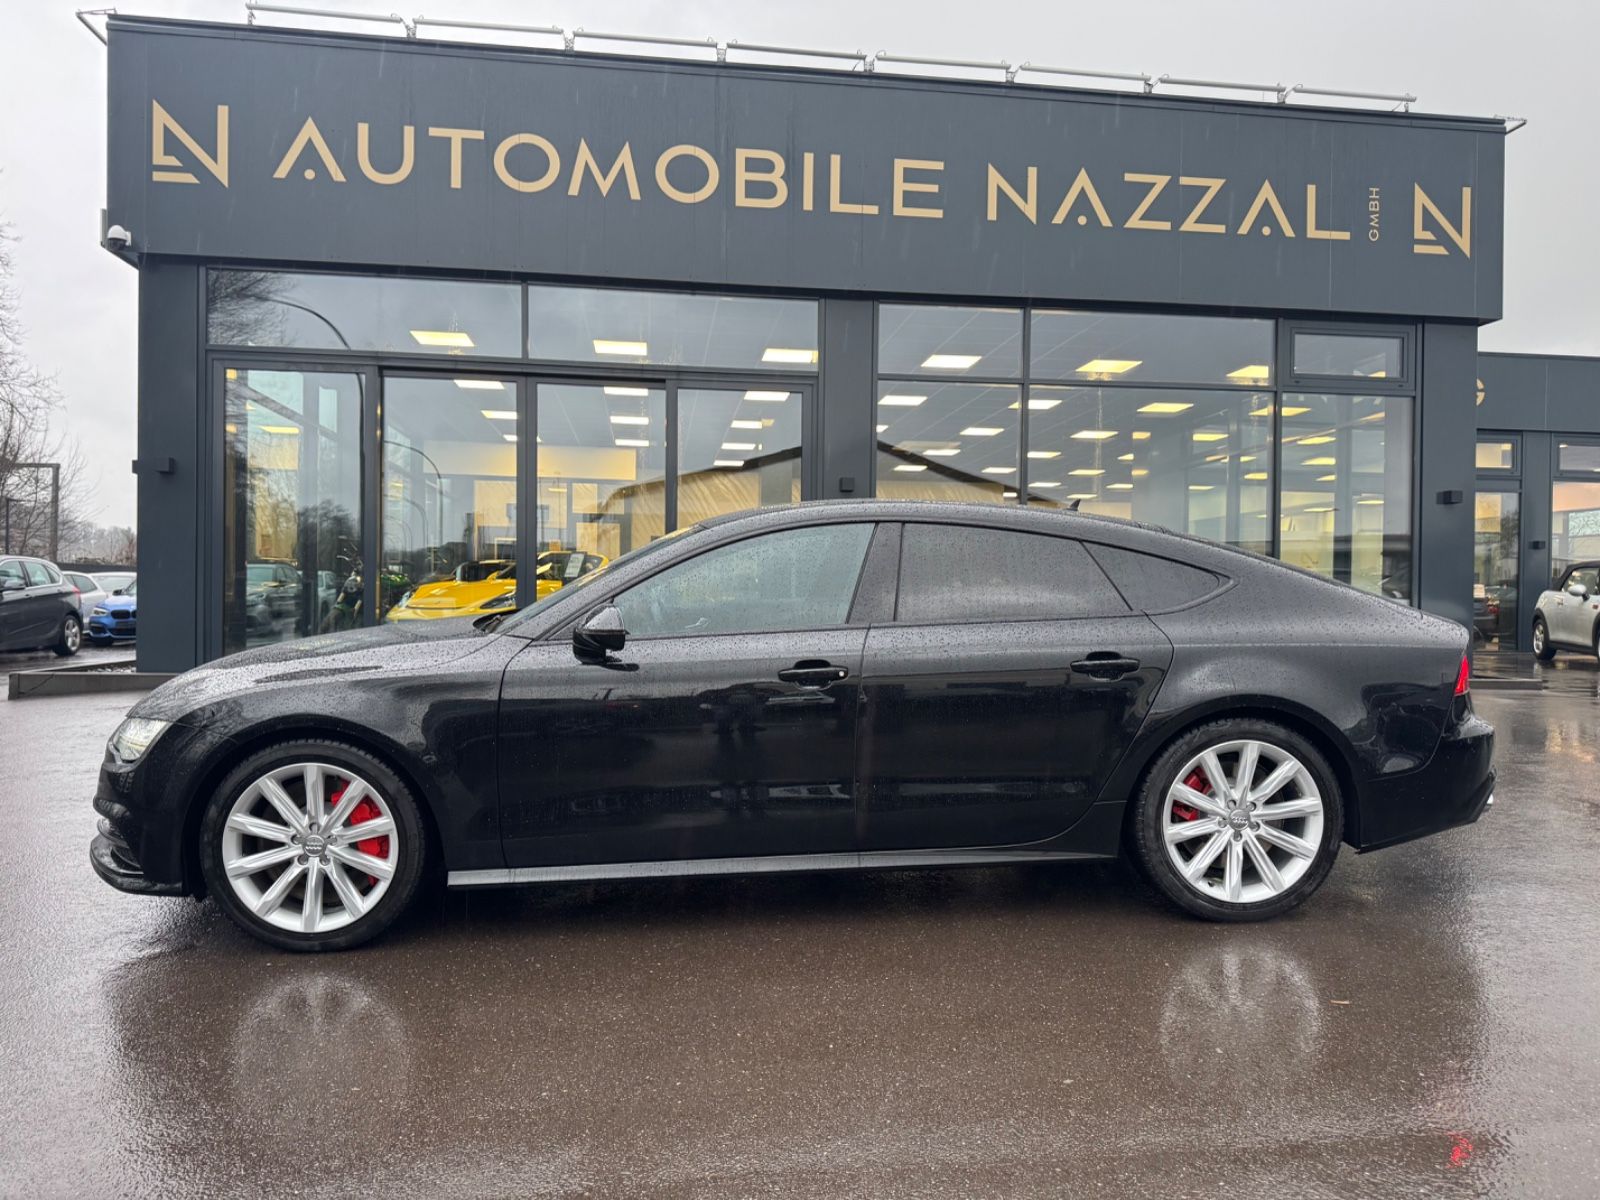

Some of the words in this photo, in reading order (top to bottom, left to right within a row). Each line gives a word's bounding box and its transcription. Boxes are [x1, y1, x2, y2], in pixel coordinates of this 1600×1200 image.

[273, 117, 945, 221] AUTOMOBILE
[987, 162, 1351, 241] NAZZAL
[1368, 187, 1380, 242] GMBH
